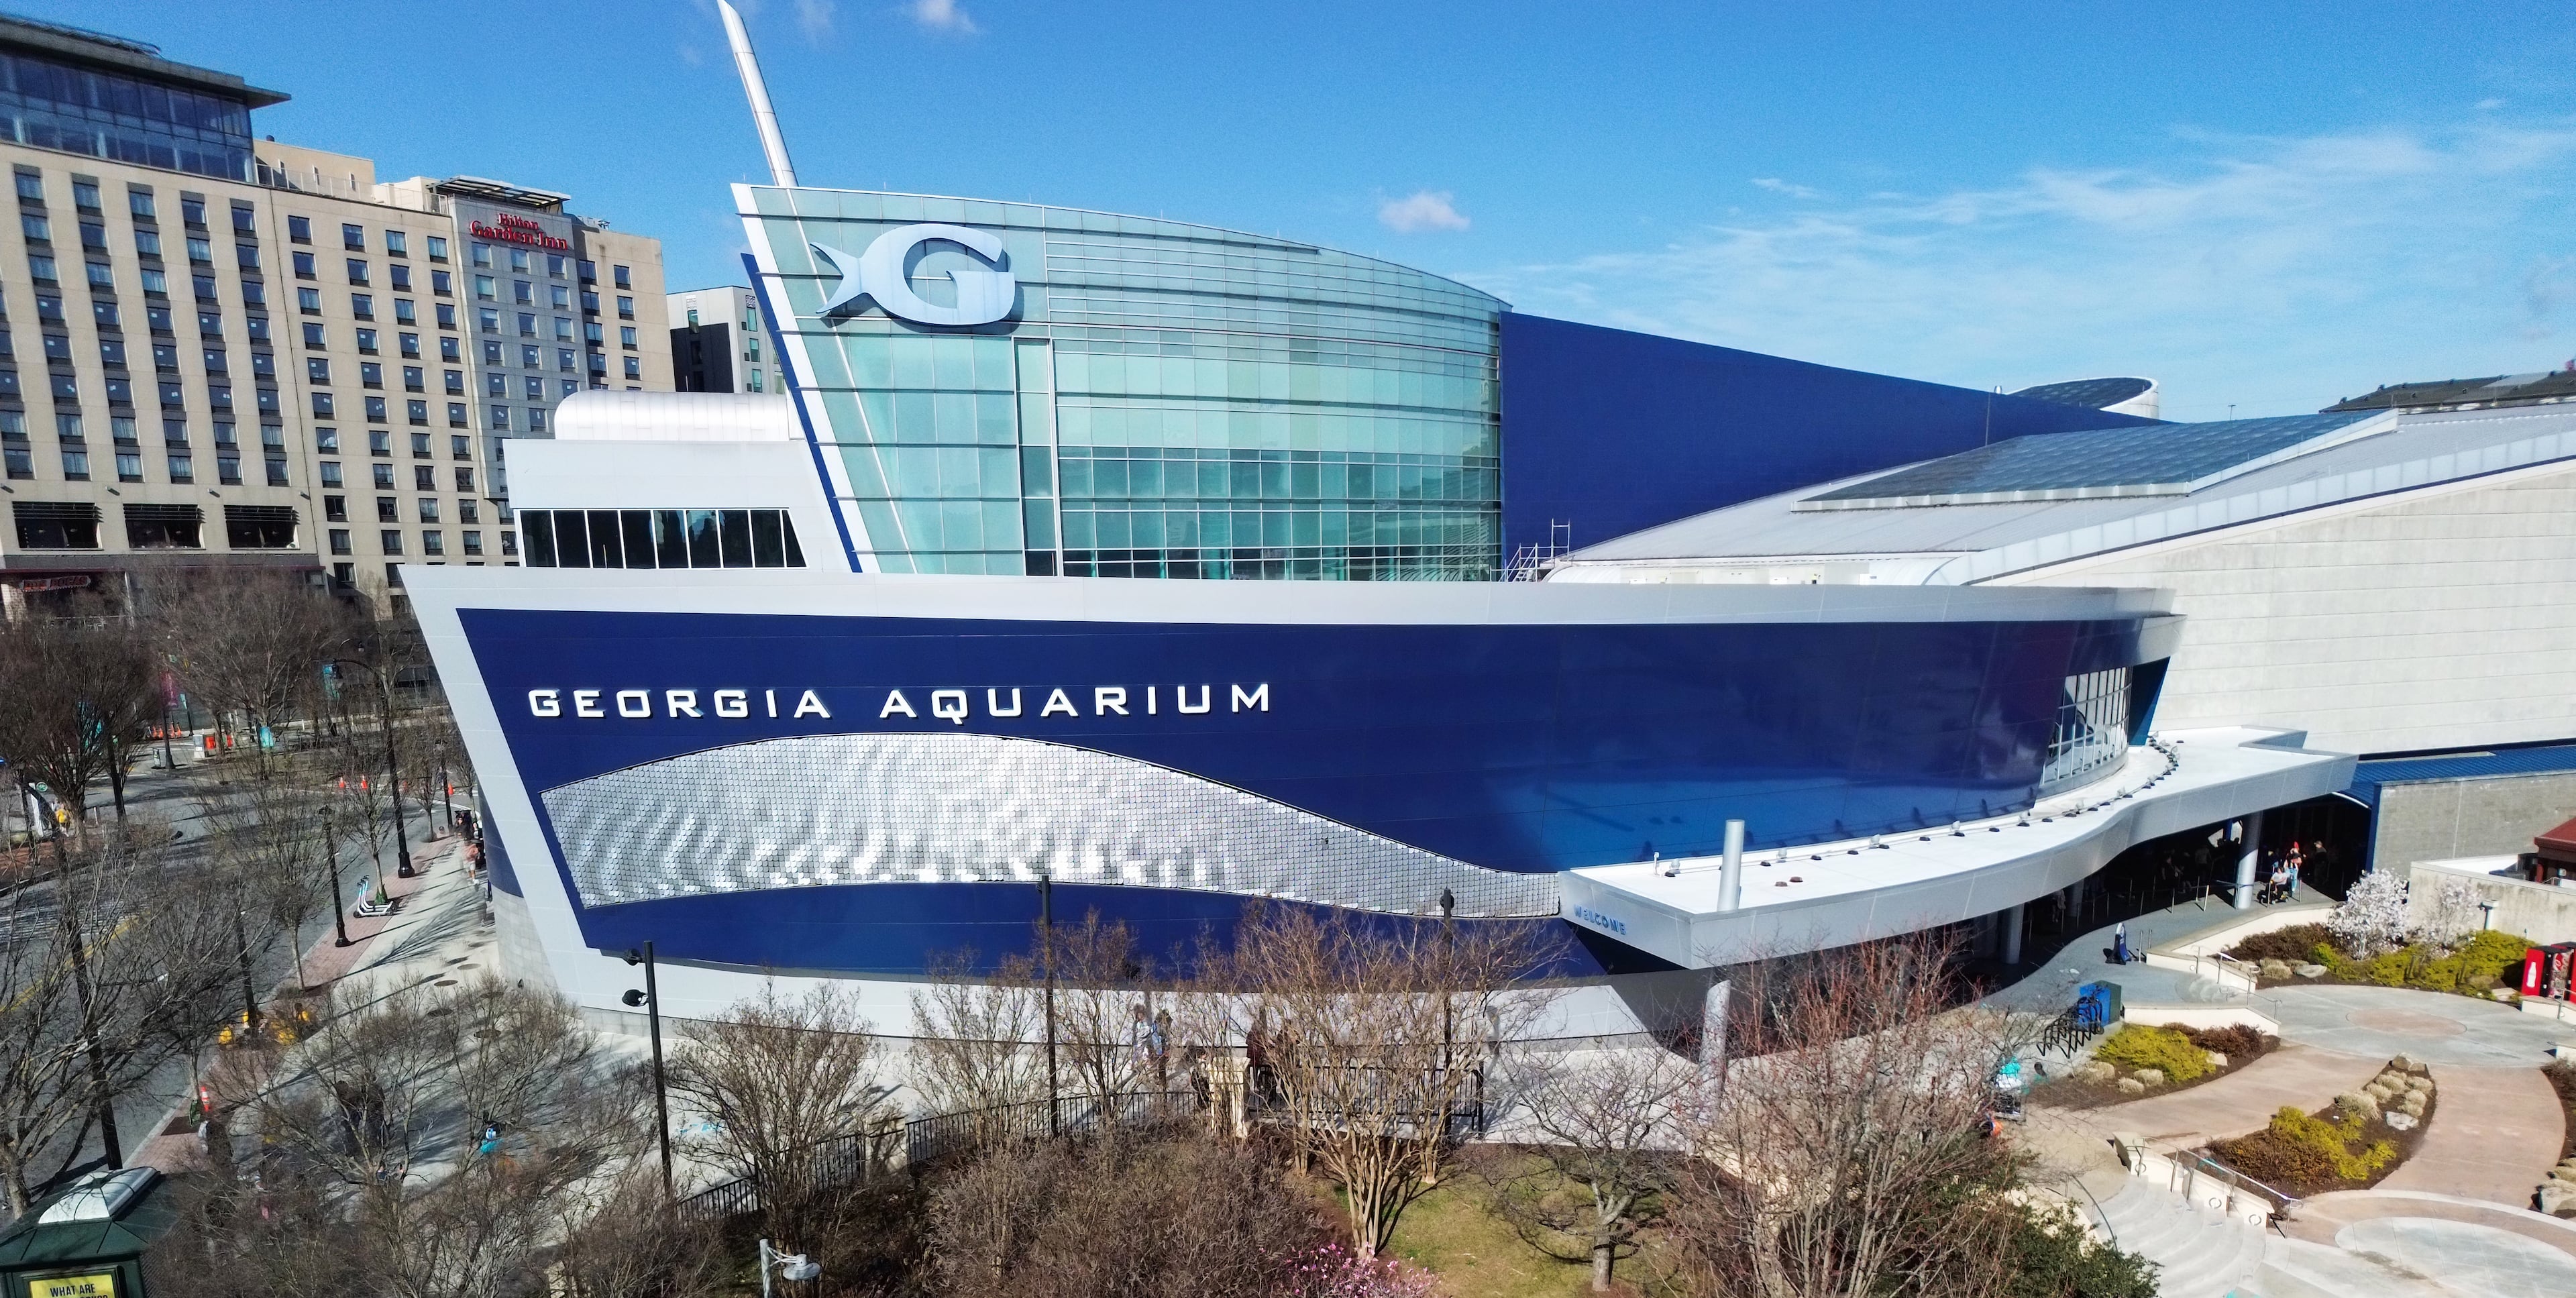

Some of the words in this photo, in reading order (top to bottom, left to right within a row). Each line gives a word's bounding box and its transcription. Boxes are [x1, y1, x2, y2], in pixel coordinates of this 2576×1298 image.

[470, 220, 534, 244] Garden
[537, 231, 568, 250] Inn
[498, 213, 539, 230] Hilton
[528, 689, 832, 718] GEORGIA
[879, 684, 1270, 724] AQUARIUM
[1574, 904, 1626, 935] WELCOME
[50, 1285, 76, 1297] WHAT
[79, 1283, 96, 1295] ARE
